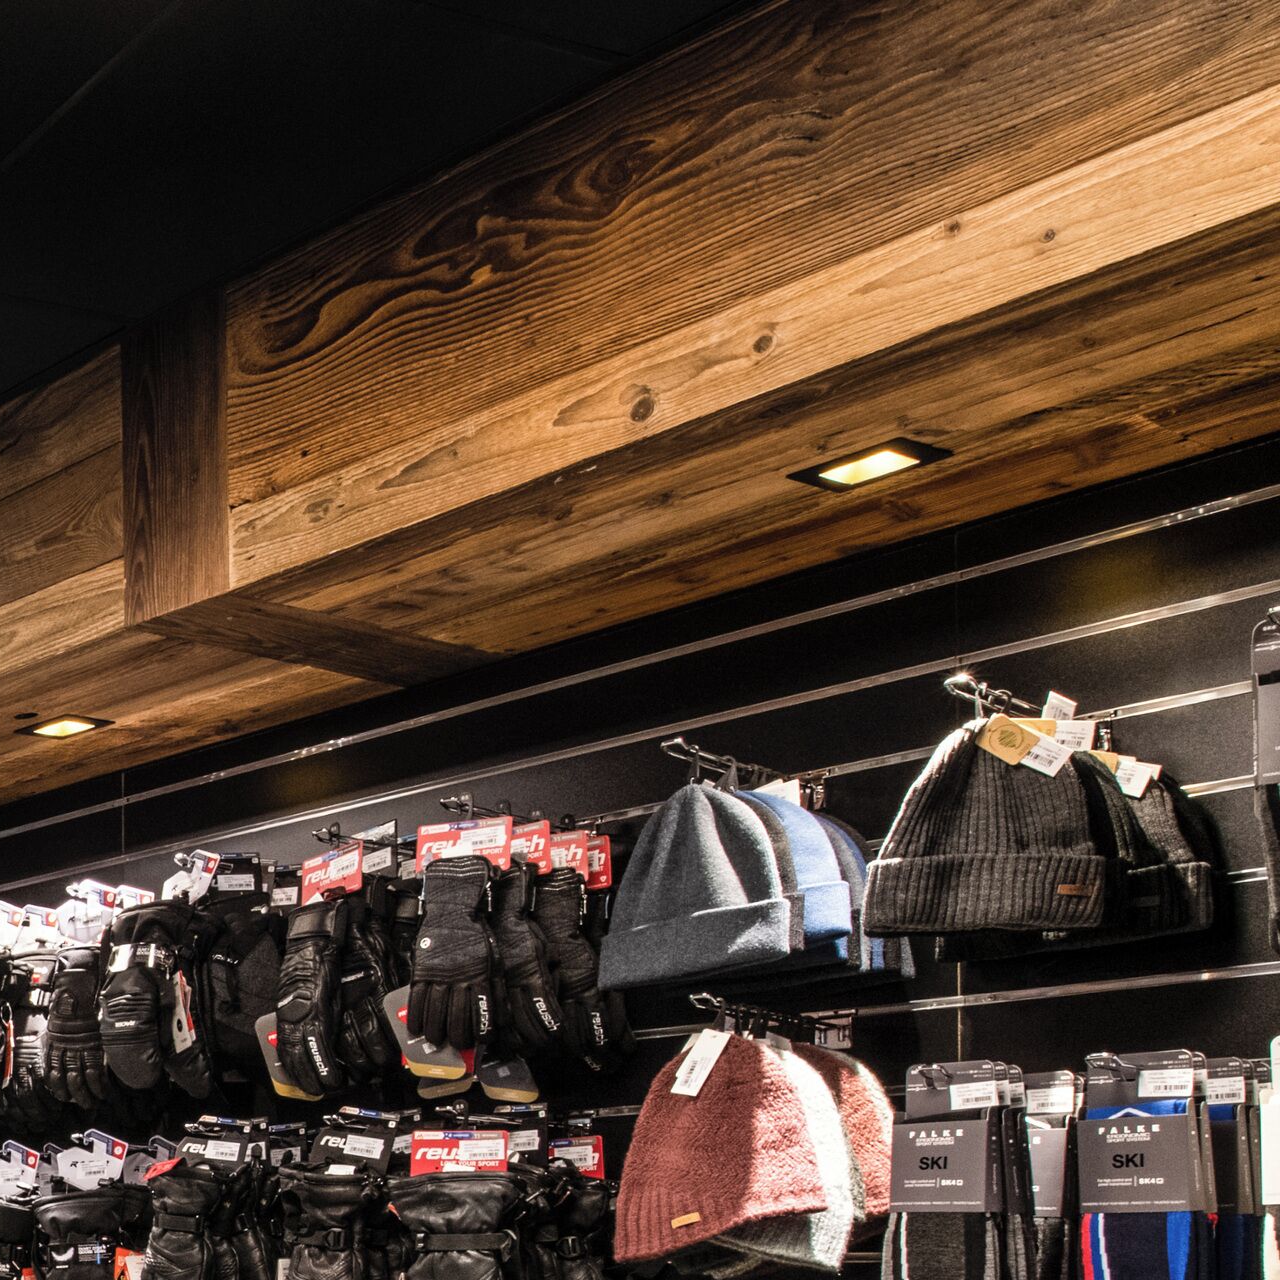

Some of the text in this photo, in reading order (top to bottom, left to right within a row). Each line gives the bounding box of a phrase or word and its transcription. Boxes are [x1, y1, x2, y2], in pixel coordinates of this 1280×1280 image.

[478, 994, 492, 1035] reusch
[533, 996, 561, 1033] reusch
[590, 1011, 609, 1046] reusch
[307, 1036, 328, 1076] reusch
[909, 1129, 964, 1139] FALKE
[1098, 1124, 1161, 1135] FALKE
[478, 1160, 500, 1168] SPORT
[919, 1156, 948, 1170] SKI
[1112, 1153, 1145, 1168] SKI
